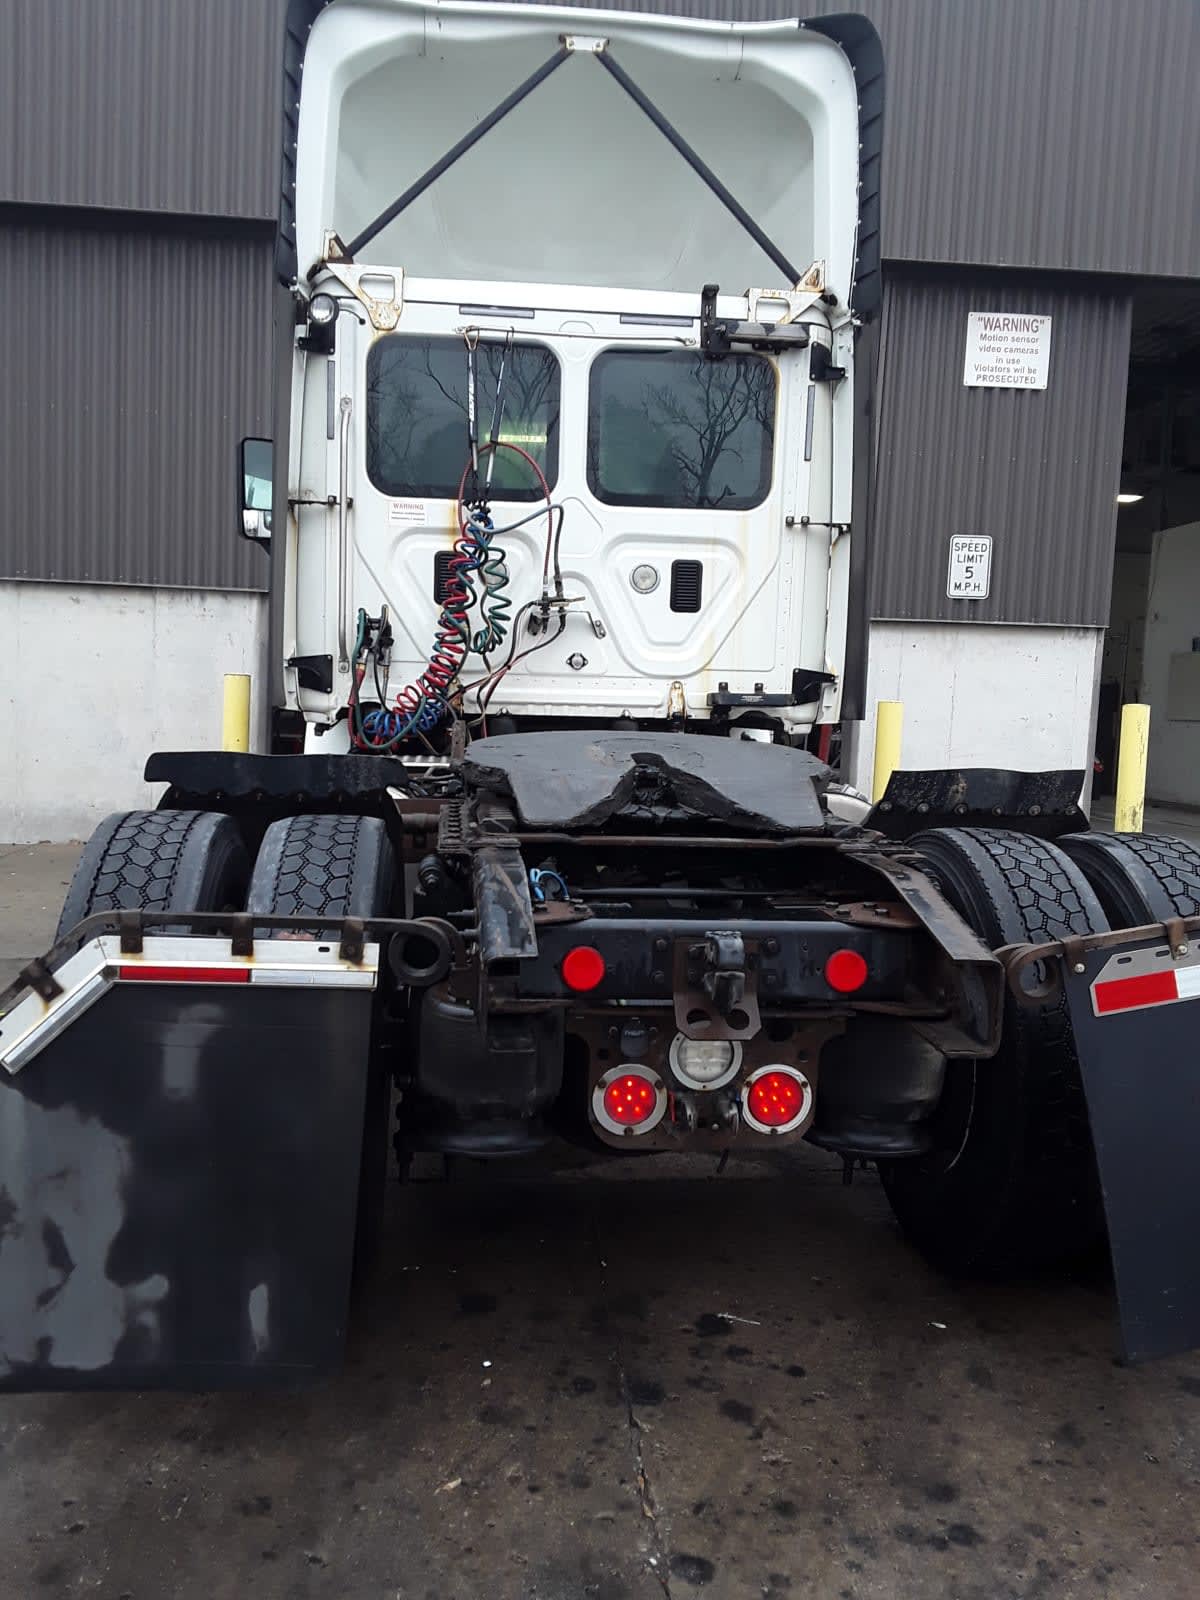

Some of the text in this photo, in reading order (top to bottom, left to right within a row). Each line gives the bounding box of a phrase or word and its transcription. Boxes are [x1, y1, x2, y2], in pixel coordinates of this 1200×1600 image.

[978, 317, 1045, 333] "WARNING"
[980, 333, 1040, 343] Motion sensor
[979, 345, 1039, 355] video cameras
[995, 356, 1004, 364] in
[974, 364, 1011, 373] Violators
[1027, 366, 1037, 375] be
[976, 374, 1036, 384] PROSECUTED
[954, 542, 988, 553] SPEED
[957, 553, 984, 564] LIMIT
[965, 566, 974, 579] 5
